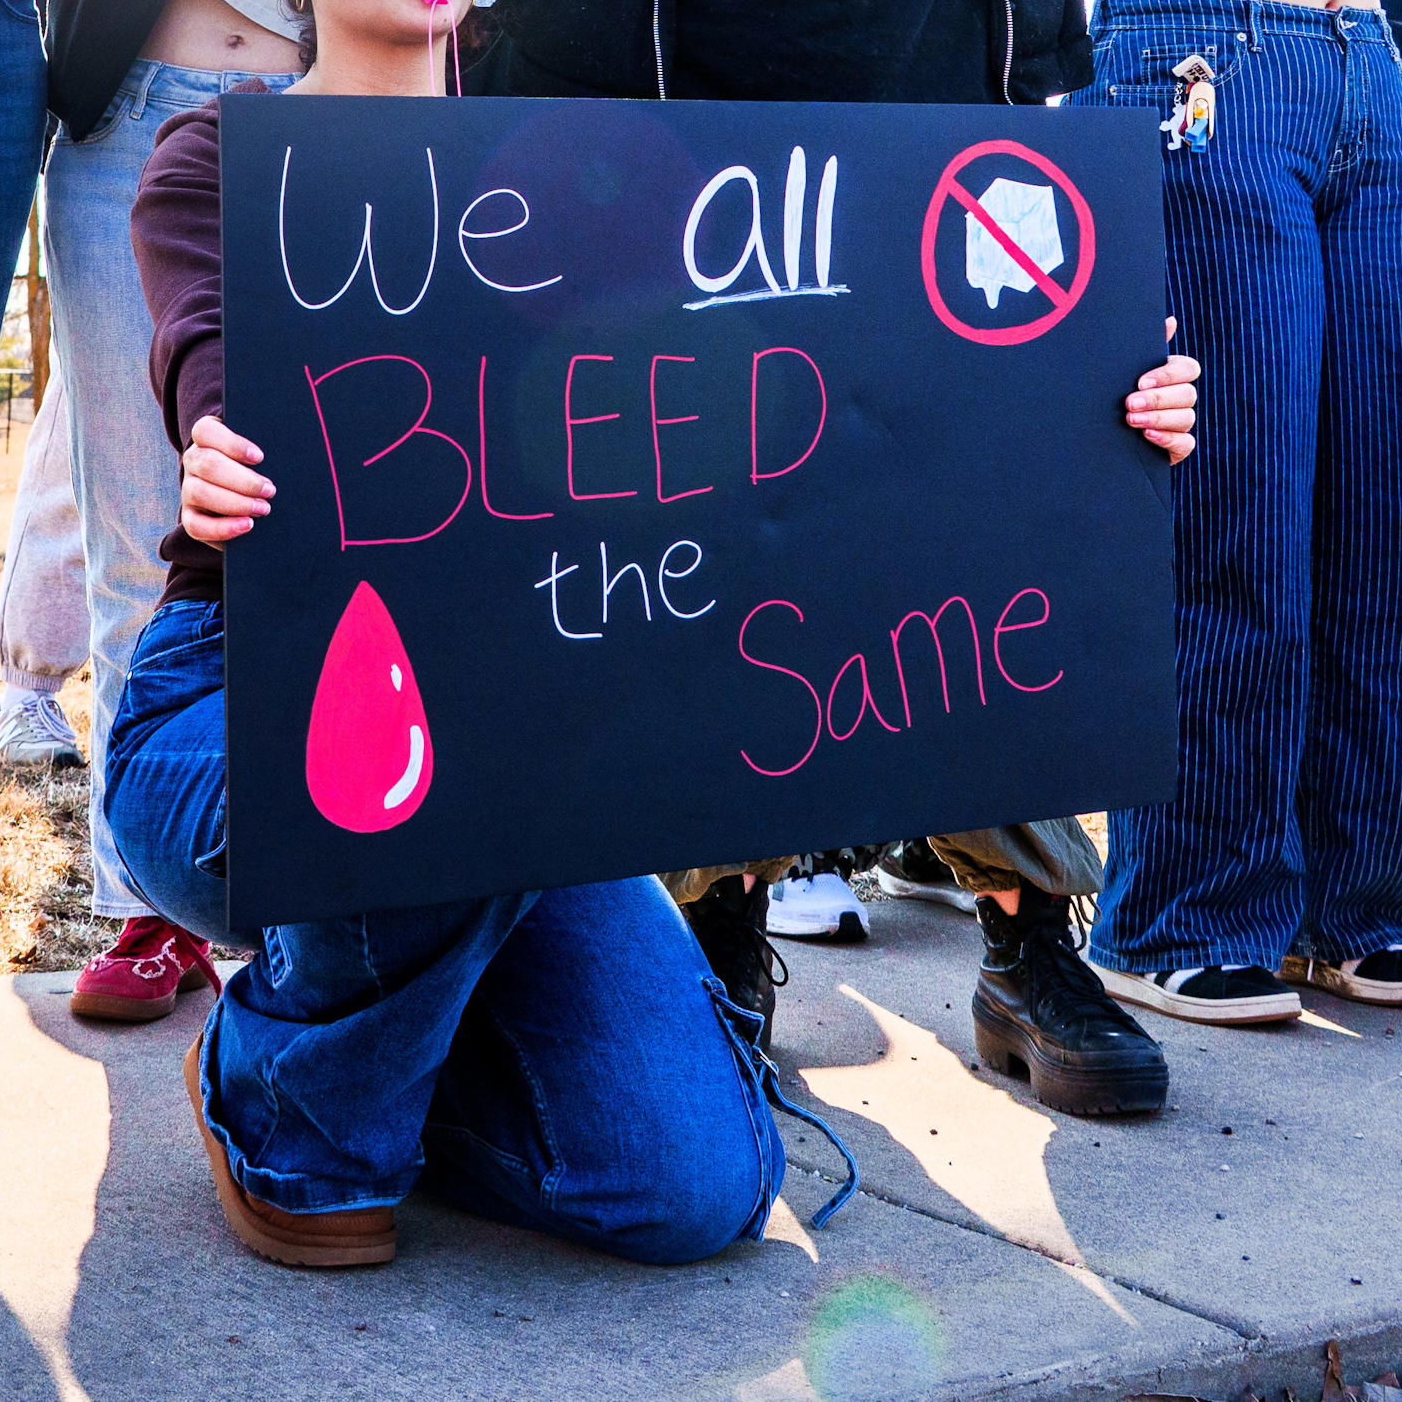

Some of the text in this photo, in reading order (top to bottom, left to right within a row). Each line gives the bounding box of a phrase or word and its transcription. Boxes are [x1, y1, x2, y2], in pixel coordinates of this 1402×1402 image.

[278, 145, 839, 316] We all
[304, 346, 828, 551] BLEED
[533, 538, 716, 639] the
[739, 587, 1064, 777] Same
